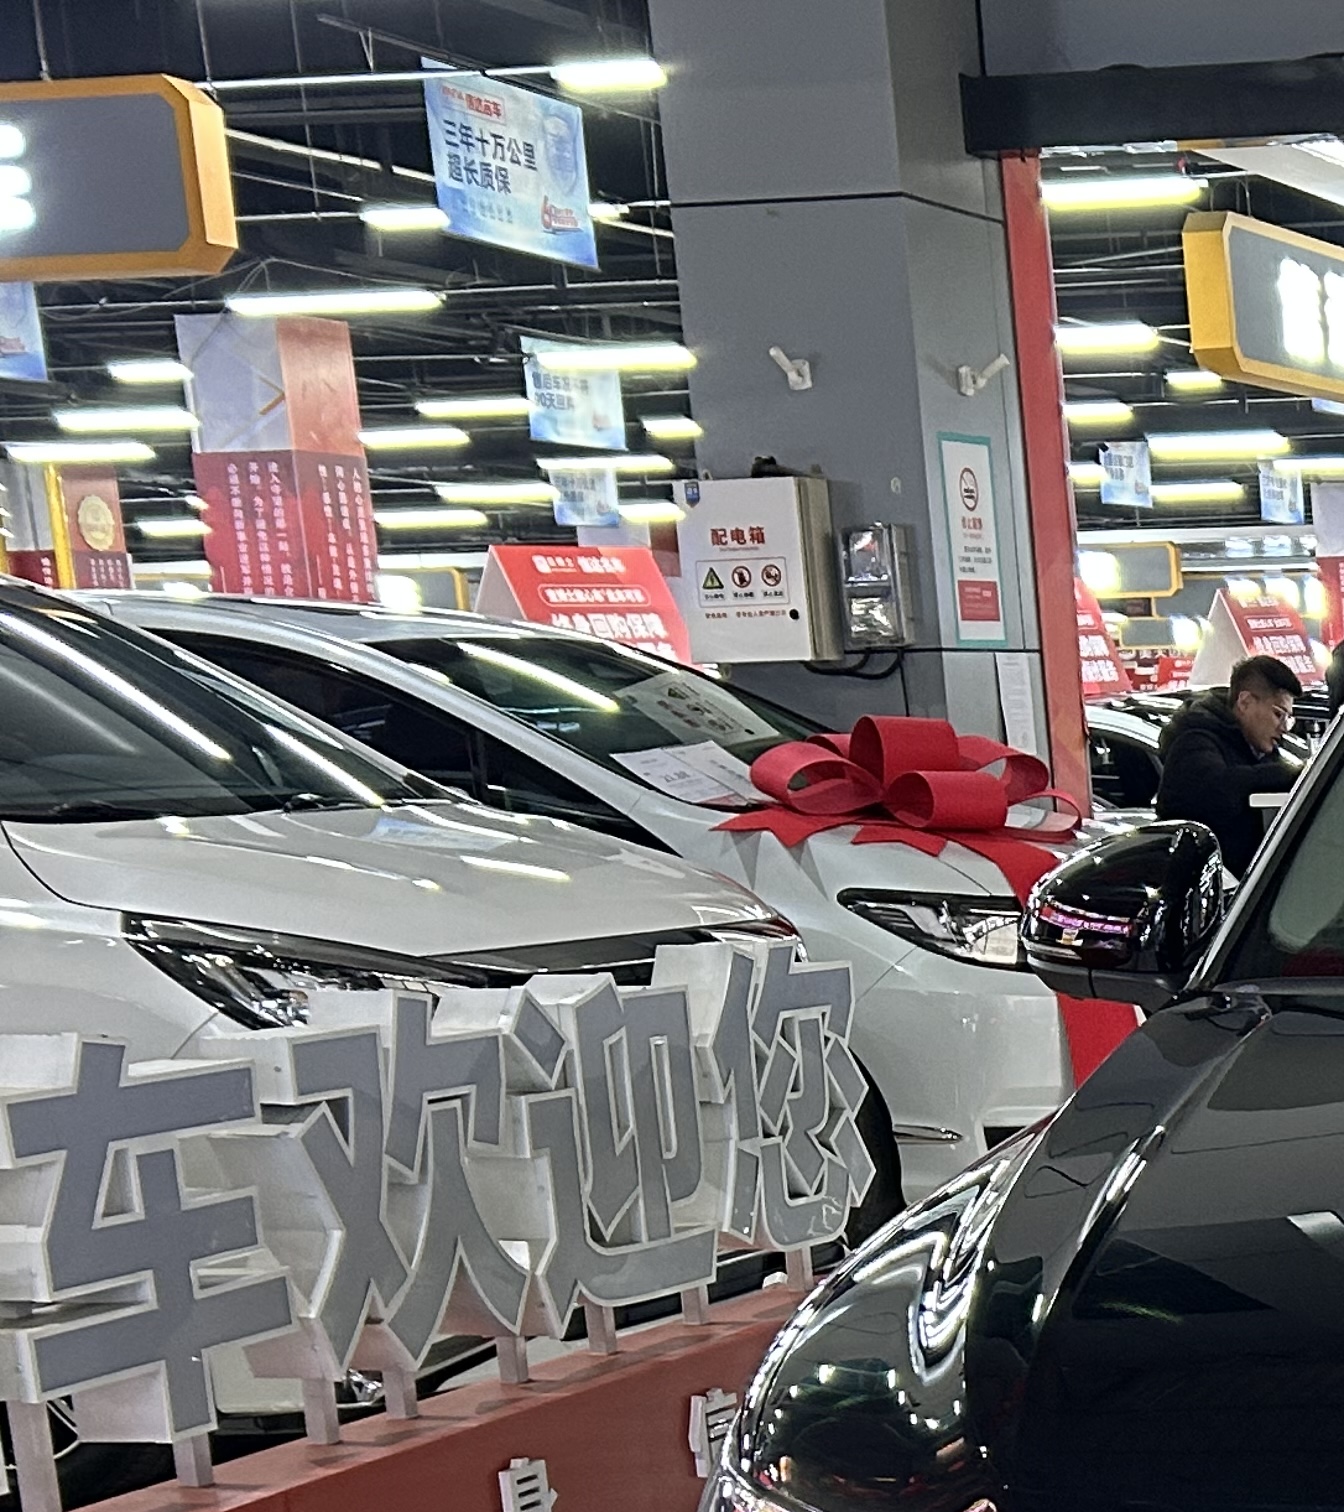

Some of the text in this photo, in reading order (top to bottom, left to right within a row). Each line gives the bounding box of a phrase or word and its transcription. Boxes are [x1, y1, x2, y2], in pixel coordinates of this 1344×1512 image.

[443, 119, 538, 171] 三年十万公里
[447, 153, 512, 195] 超长质保
[710, 526, 766, 546] 配电箱
